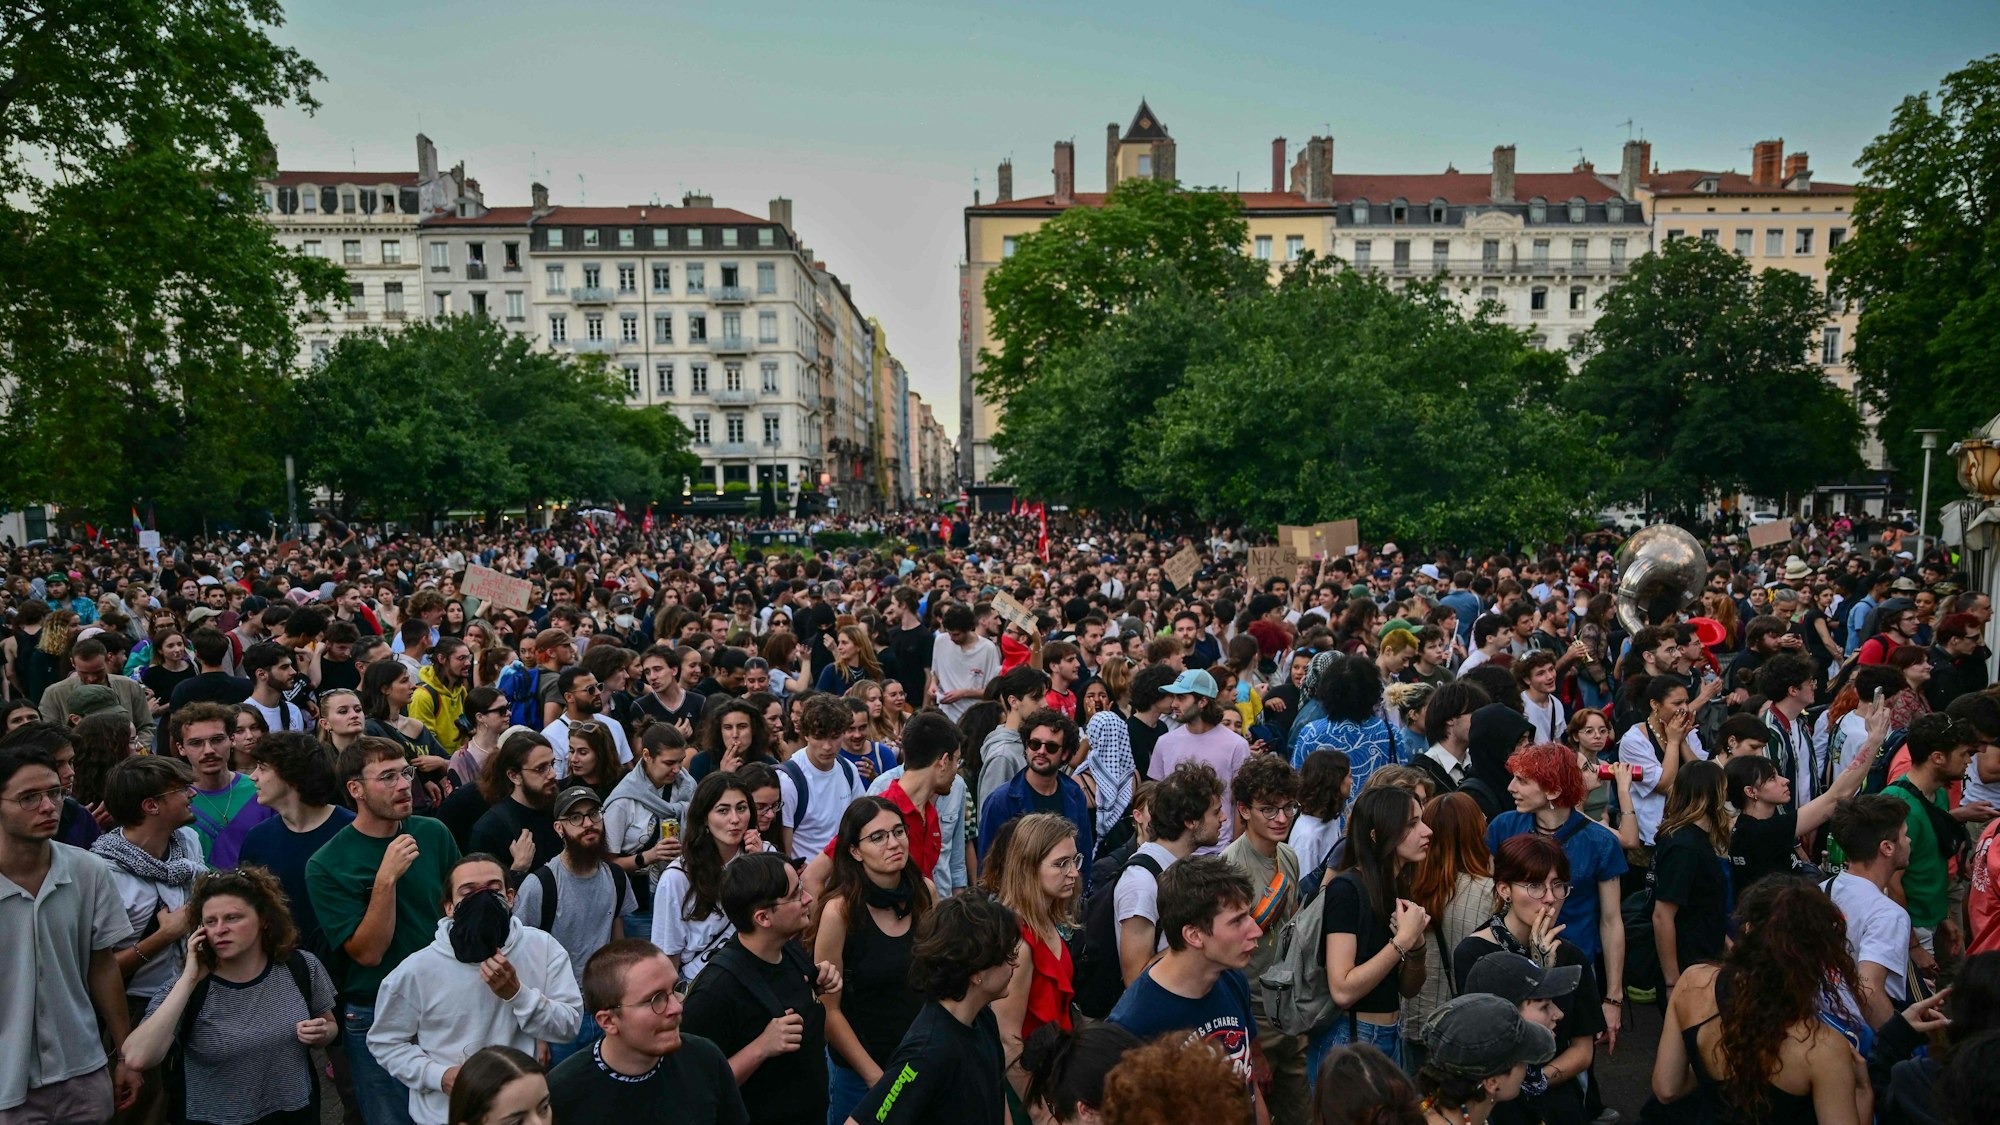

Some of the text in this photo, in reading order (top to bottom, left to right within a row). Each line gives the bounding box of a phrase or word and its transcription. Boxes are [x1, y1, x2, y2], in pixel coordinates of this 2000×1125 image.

[1252, 549, 1279, 565] NIK
[1213, 1016, 1239, 1028] CHARGE
[876, 1062, 918, 1123] Ibanez
